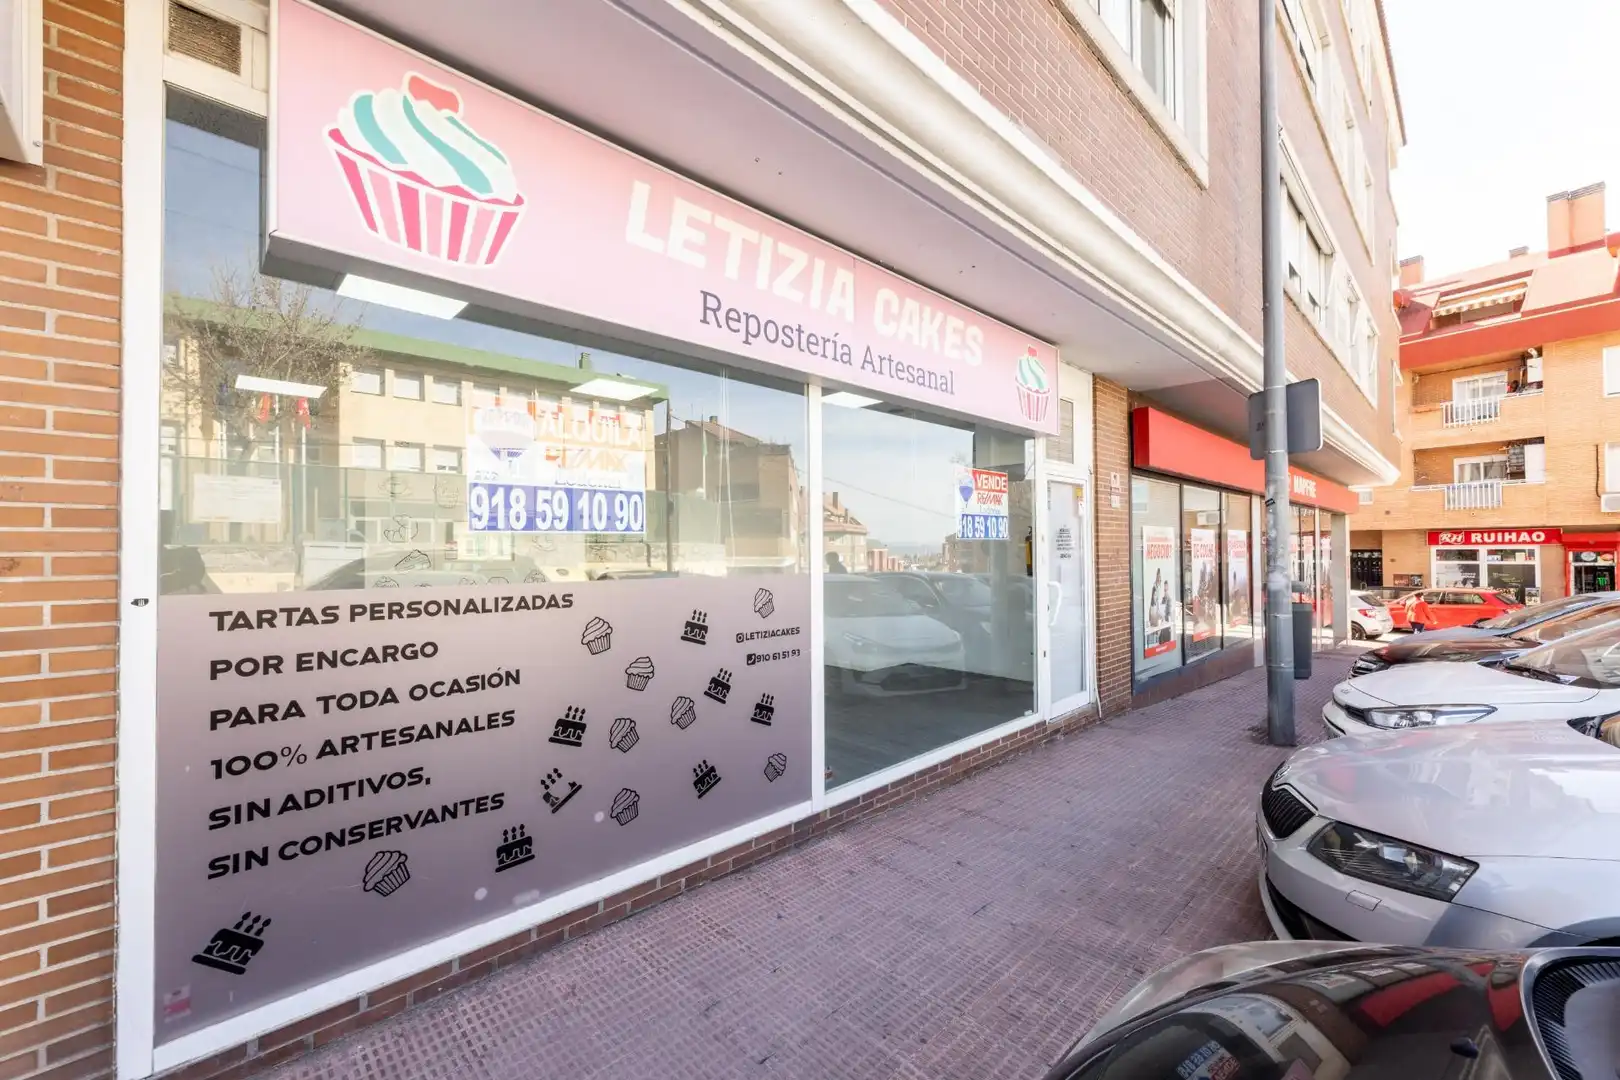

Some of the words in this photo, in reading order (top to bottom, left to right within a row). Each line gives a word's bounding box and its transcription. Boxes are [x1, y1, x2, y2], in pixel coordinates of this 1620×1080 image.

[625, 180, 855, 324] LETIZIA
[873, 287, 984, 367] CAKES
[699, 290, 853, 368] Repostería
[860, 345, 956, 396] Artesanal
[976, 473, 1008, 491] VENDE
[470, 486, 527, 531] 918
[535, 489, 569, 531] 59
[577, 490, 608, 531] 10
[614, 493, 643, 532] 90
[974, 515, 986, 538] 59
[986, 516, 997, 538] 10
[1471, 531, 1546, 543] RUIHAO
[208, 605, 341, 633] TARTAS
[348, 592, 575, 624] PERSONALIZADAS
[745, 627, 800, 641] LETIZIACAKES
[209, 653, 284, 682] POR
[295, 641, 439, 674] ENCARGO
[756, 654, 770, 662] 910
[772, 652, 780, 660] 61
[782, 651, 789, 659] 51
[791, 649, 800, 657] 93
[209, 698, 306, 732] PARA
[316, 686, 400, 716] TODA
[408, 666, 521, 703] OCASIÓN
[210, 743, 308, 781] 100%
[315, 709, 516, 761] ARTESANALES
[208, 796, 272, 831] SIN
[276, 766, 432, 816] ADITIVOS,
[207, 845, 269, 880] SIN
[277, 791, 505, 862] CONSERVANTES
